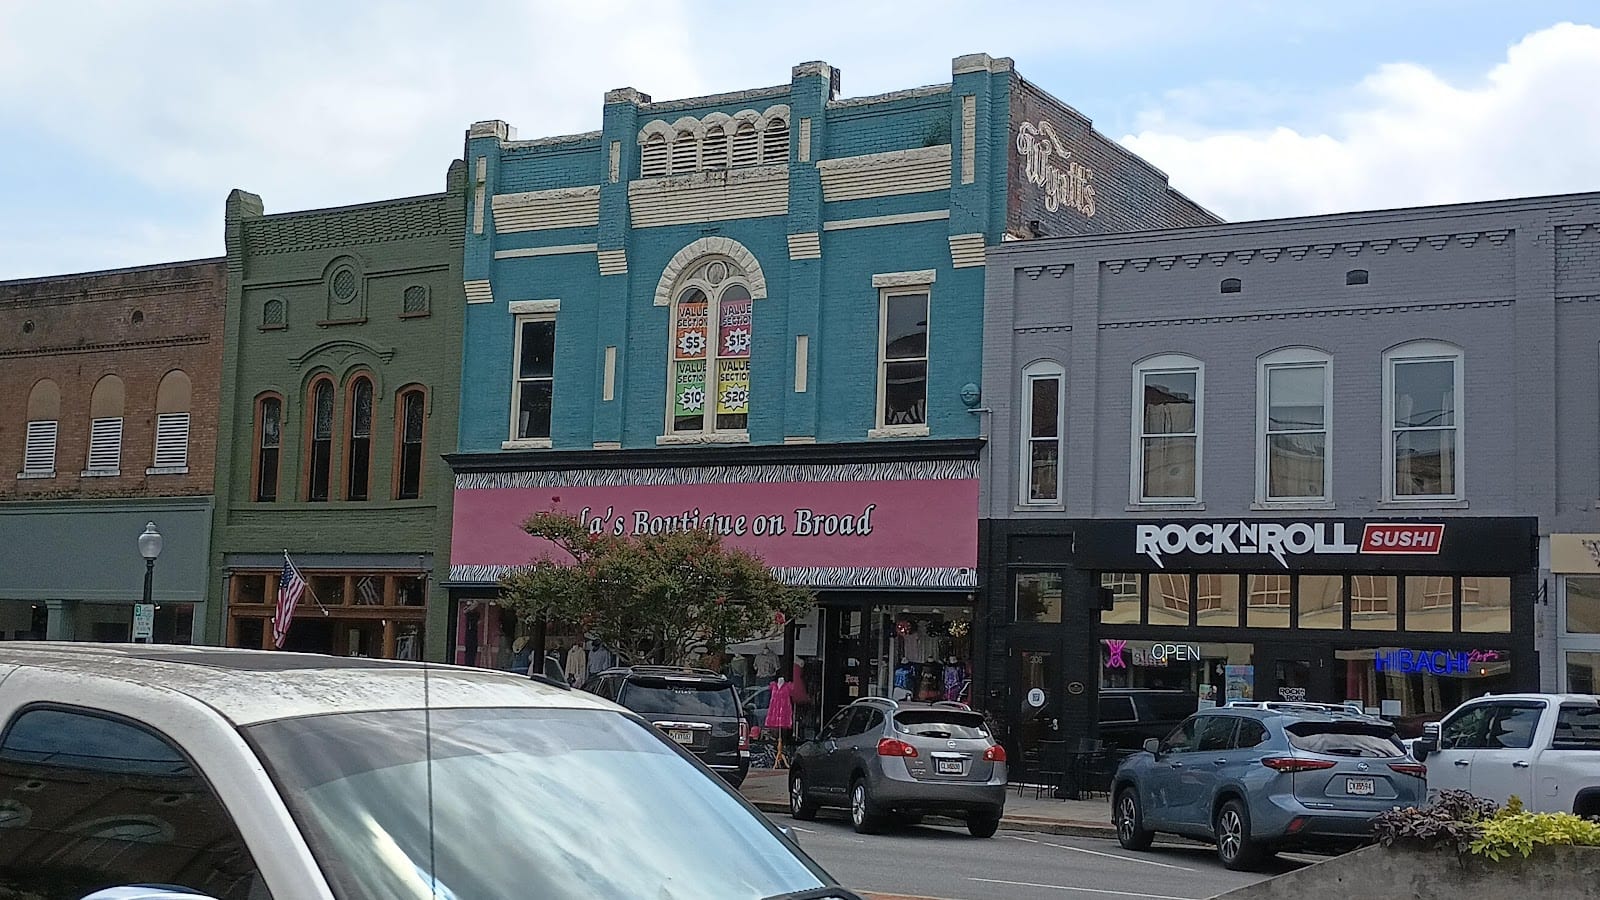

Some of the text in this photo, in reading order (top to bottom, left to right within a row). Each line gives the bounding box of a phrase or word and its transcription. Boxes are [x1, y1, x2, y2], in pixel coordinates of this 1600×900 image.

[679, 307, 708, 317] VALUE
[723, 304, 752, 315] VALUE
[686, 337, 700, 349] $5
[729, 334, 746, 346] $15
[679, 363, 706, 373] VALUE
[721, 361, 750, 371] VALUE
[677, 374, 706, 383] SECTIO
[683, 391, 701, 403] $10
[725, 391, 745, 403] $20
[630, 506, 747, 537] Boutique
[752, 513, 787, 537] on
[792, 504, 877, 537] Broad
[1369, 530, 1437, 548] SUSHI
[1152, 643, 1201, 662] OPEN
[1375, 648, 1469, 674] HIBACHI
